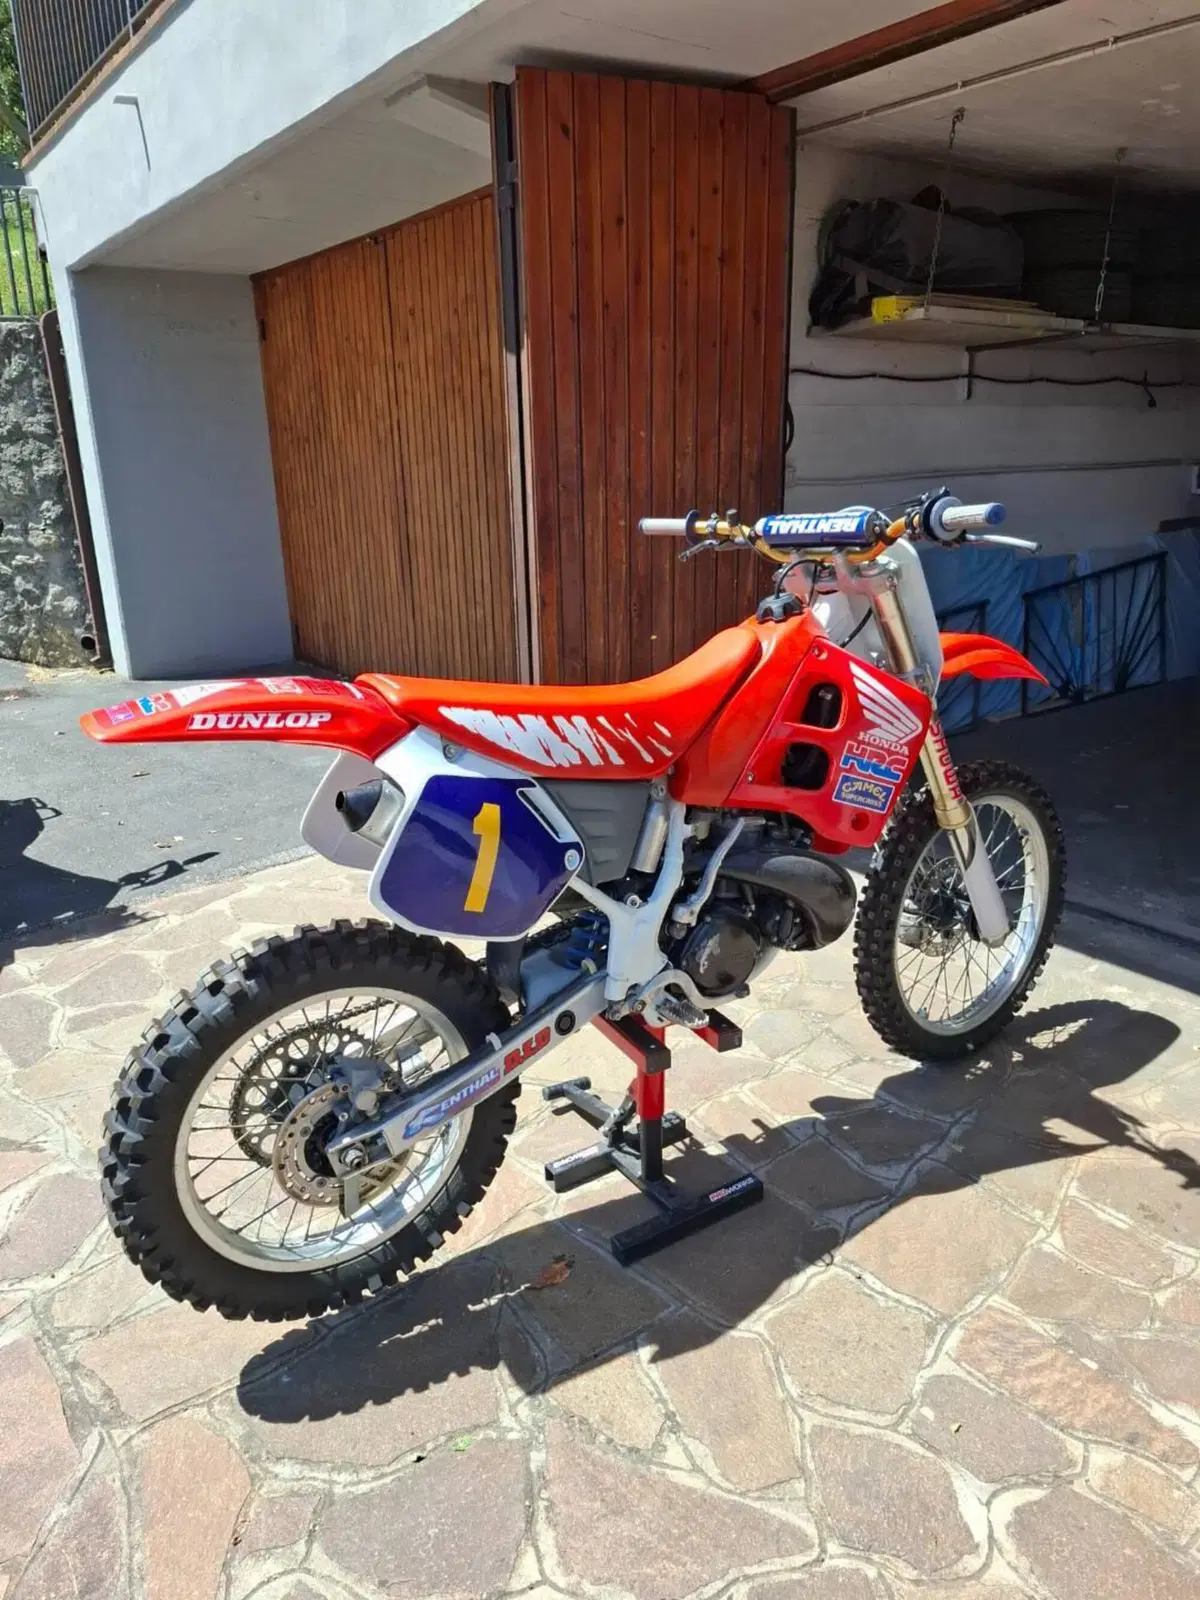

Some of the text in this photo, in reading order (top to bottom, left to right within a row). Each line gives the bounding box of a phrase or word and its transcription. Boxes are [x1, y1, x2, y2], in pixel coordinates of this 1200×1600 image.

[769, 517, 859, 535] RENTHAL
[188, 712, 331, 730] DUNLOP
[857, 731, 910, 755] HONDA
[840, 740, 909, 783] HRC
[930, 721, 965, 801] SHOWA
[841, 780, 888, 802] CAMEL
[464, 803, 500, 912] 1
